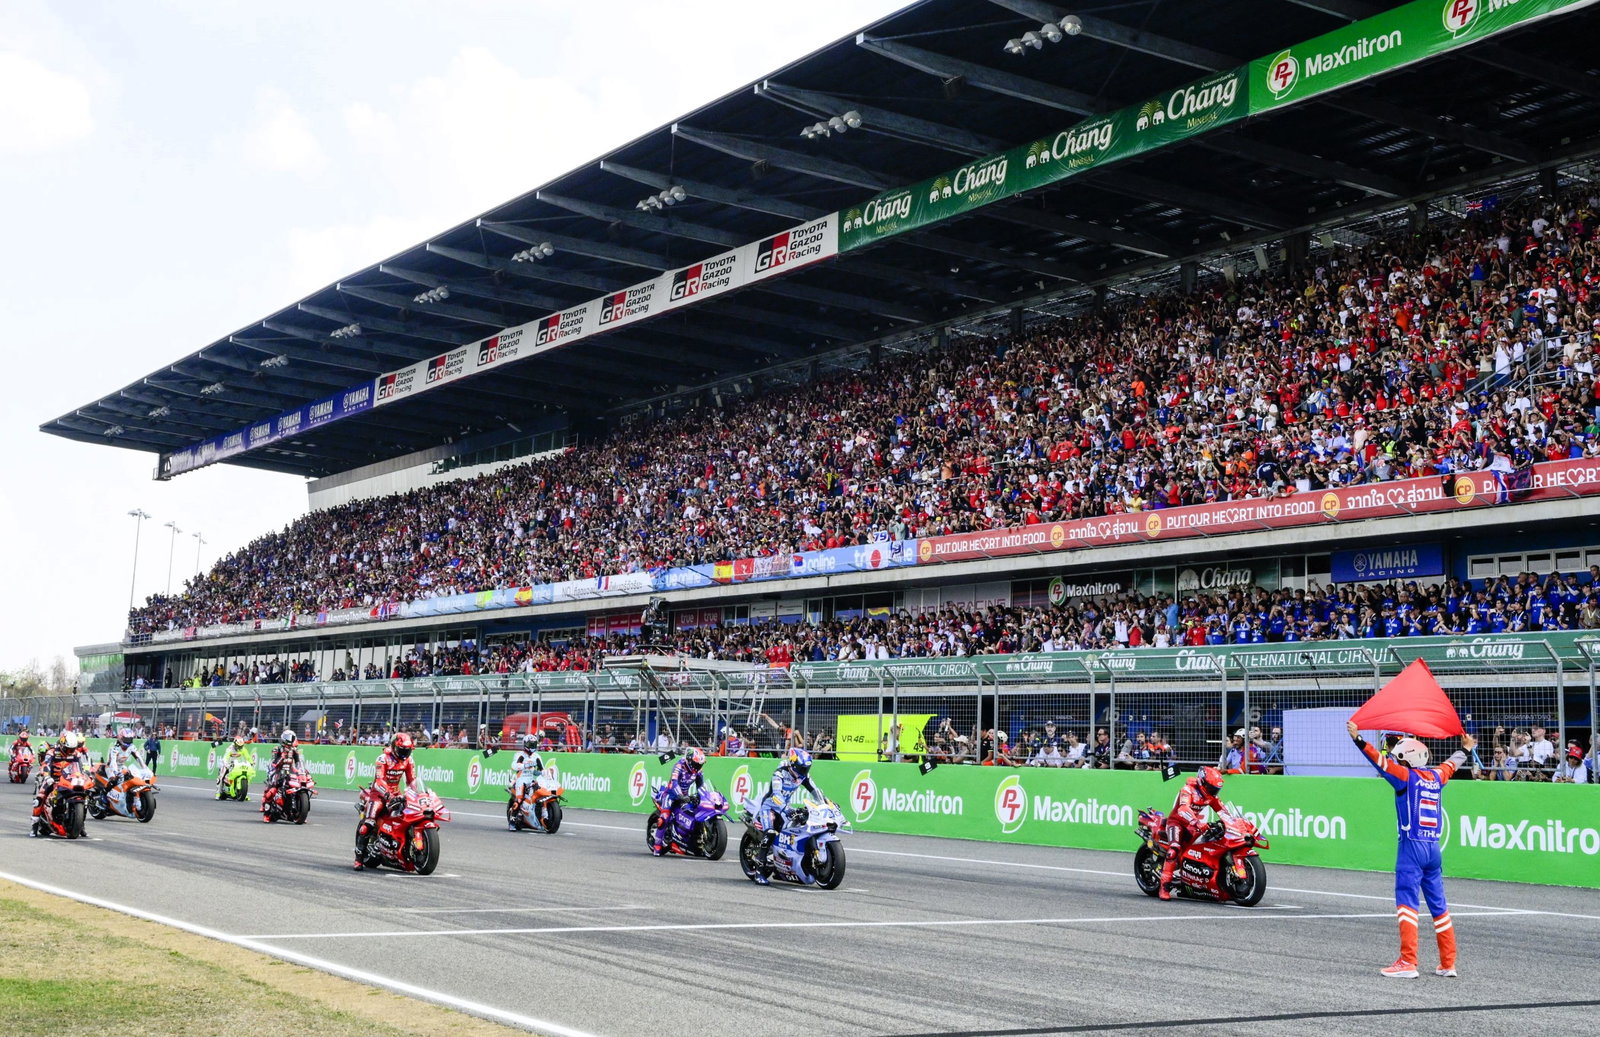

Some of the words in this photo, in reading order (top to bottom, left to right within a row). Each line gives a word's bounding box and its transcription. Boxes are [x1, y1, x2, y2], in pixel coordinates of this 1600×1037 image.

[1305, 29, 1402, 78] Maxnitron
[1167, 77, 1238, 121] Chang
[1052, 122, 1113, 161] Chang
[953, 158, 1008, 195] Chang
[863, 194, 913, 226] Chang
[791, 220, 828, 240] TOYOTA
[789, 232, 824, 251] GAZOO
[755, 245, 788, 274] GR
[788, 243, 821, 262] Racing
[703, 255, 737, 271] TOYOTA
[701, 266, 732, 282] GAZOO
[628, 283, 655, 298] TOYOTA
[670, 276, 699, 302] GR
[700, 276, 730, 292] Racing
[626, 293, 651, 308] GAZOO
[561, 307, 587, 321] TOYOTA
[599, 304, 624, 325] GR
[624, 303, 649, 318] Racing
[558, 326, 582, 339] Racing
[559, 317, 584, 330] GAZOO
[498, 338, 520, 351] GAZOO
[499, 329, 524, 343] TOYOTA
[535, 326, 559, 347] GR
[447, 349, 467, 362] TOYOTA
[477, 346, 498, 367] GR
[496, 347, 518, 360] Racing
[444, 366, 463, 377] Racing
[445, 358, 464, 369] GAZOO
[395, 377, 413, 388] GAZOO
[397, 368, 416, 380] TOYOTA
[427, 365, 444, 384] GR
[348, 386, 369, 405] YAMAHA
[377, 383, 395, 400] GR
[394, 384, 412, 394] Racing
[314, 399, 333, 420] YAMAHA
[1347, 490, 1385, 510] จากใจ
[1406, 484, 1444, 509] สู่จาน
[1458, 484, 1472, 497] CP
[1167, 515, 1188, 529] PUT
[1188, 512, 1211, 527] OUR
[1256, 504, 1282, 519] INTO
[1284, 500, 1315, 516] FOOD
[1323, 500, 1337, 511] CP
[1069, 522, 1096, 539] จากใจ
[1112, 518, 1138, 540] สู่จาน
[1148, 520, 1160, 530] CP
[872, 531, 887, 543] 79
[935, 542, 951, 555] PUT
[951, 540, 968, 553] OUR
[1001, 534, 1021, 548] INTO
[1022, 531, 1046, 546] FOOD
[1052, 531, 1063, 540] CP
[1368, 549, 1418, 569] YAMAHA
[1358, 568, 1415, 578] RACING
[1066, 581, 1121, 598] Maxnitron
[680, 613, 694, 624] true
[703, 610, 718, 622] true
[1470, 637, 1524, 660] Chang
[1020, 655, 1053, 673] Chang
[1100, 652, 1136, 671] Chang
[1175, 649, 1226, 675] Chang
[1230, 651, 1334, 668] INTERNATIONAL
[1337, 647, 1398, 664] CIRCUIT
[853, 735, 865, 743] 46
[418, 765, 454, 783] Maxnitron
[562, 772, 611, 792] Maxnitron
[857, 786, 871, 812] PT
[882, 787, 963, 816] Maxnitron
[1004, 789, 1020, 821] PT
[1034, 795, 1133, 826] Maxnitron
